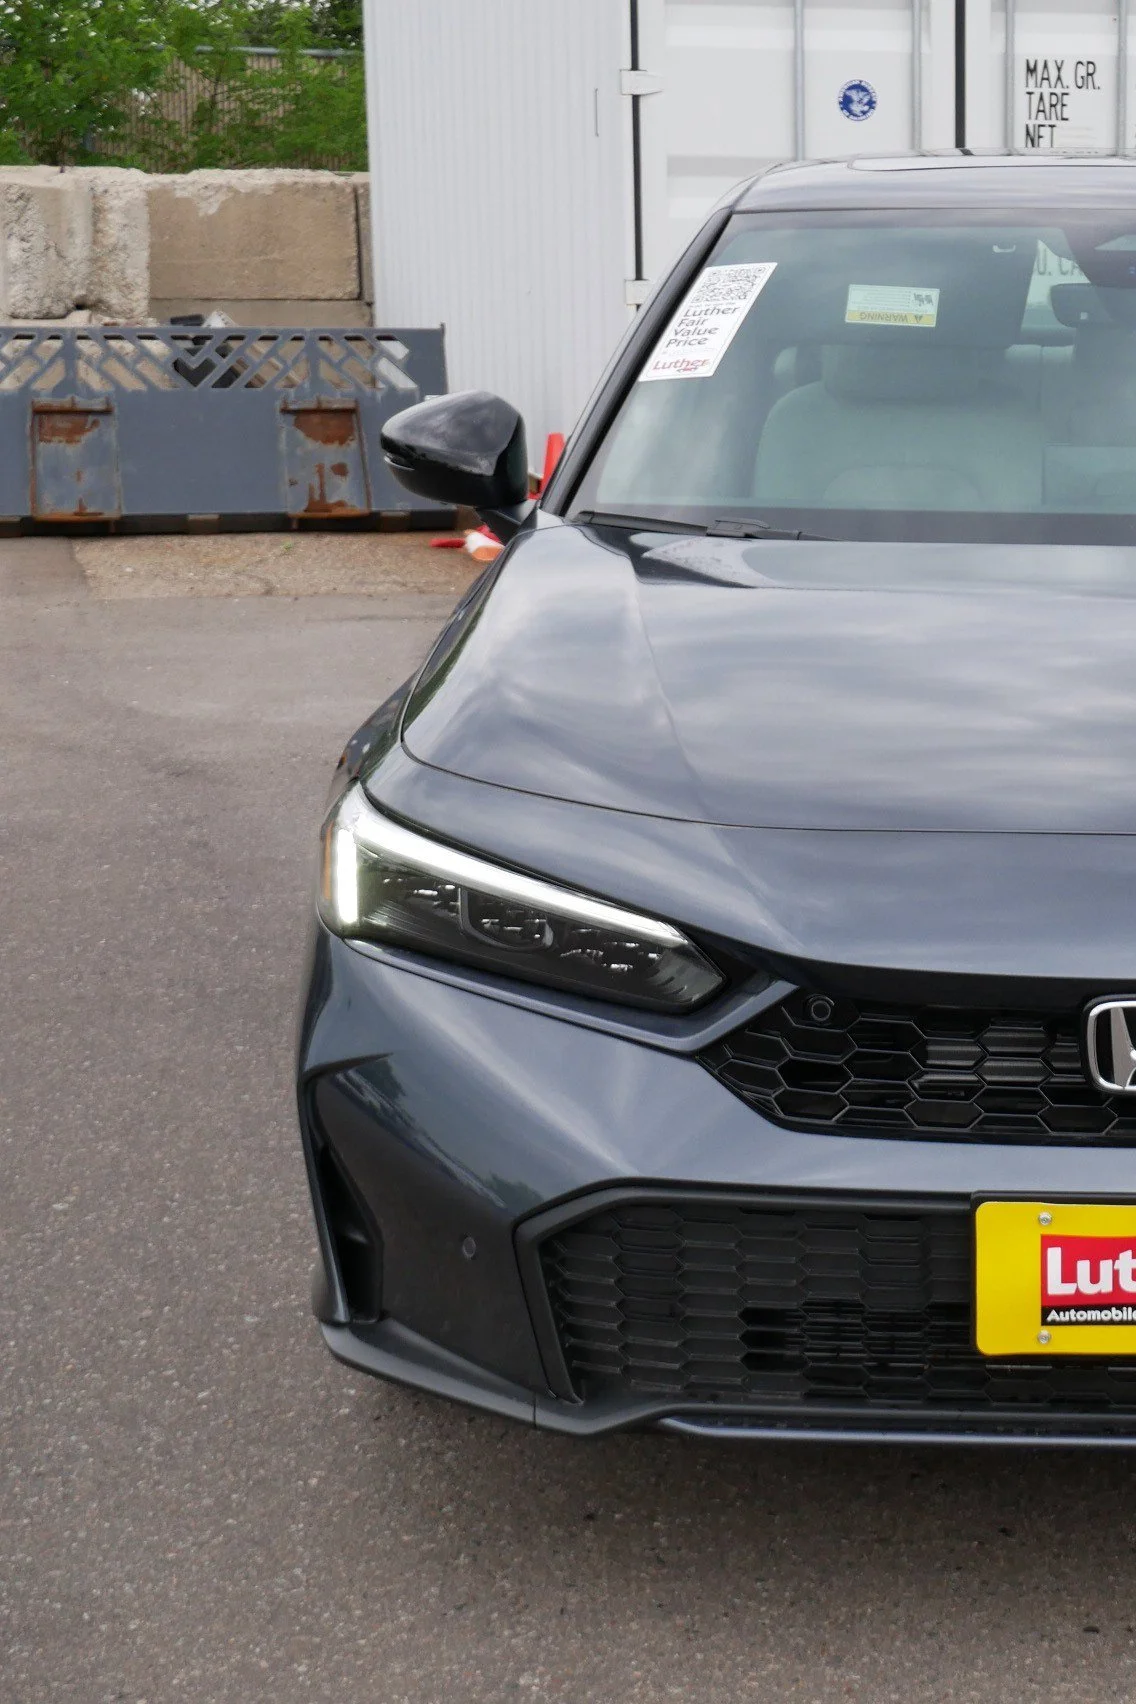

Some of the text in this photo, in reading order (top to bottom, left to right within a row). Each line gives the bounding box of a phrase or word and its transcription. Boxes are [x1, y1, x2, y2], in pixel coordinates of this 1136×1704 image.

[1025, 58, 1100, 90] MAX. GR.
[1025, 91, 1070, 121] TARE
[683, 306, 740, 317] Luther
[859, 311, 909, 323] WARNING
[677, 316, 708, 327] Fair
[674, 327, 719, 337] Value
[666, 337, 708, 348] Price
[652, 358, 710, 371] Luther
